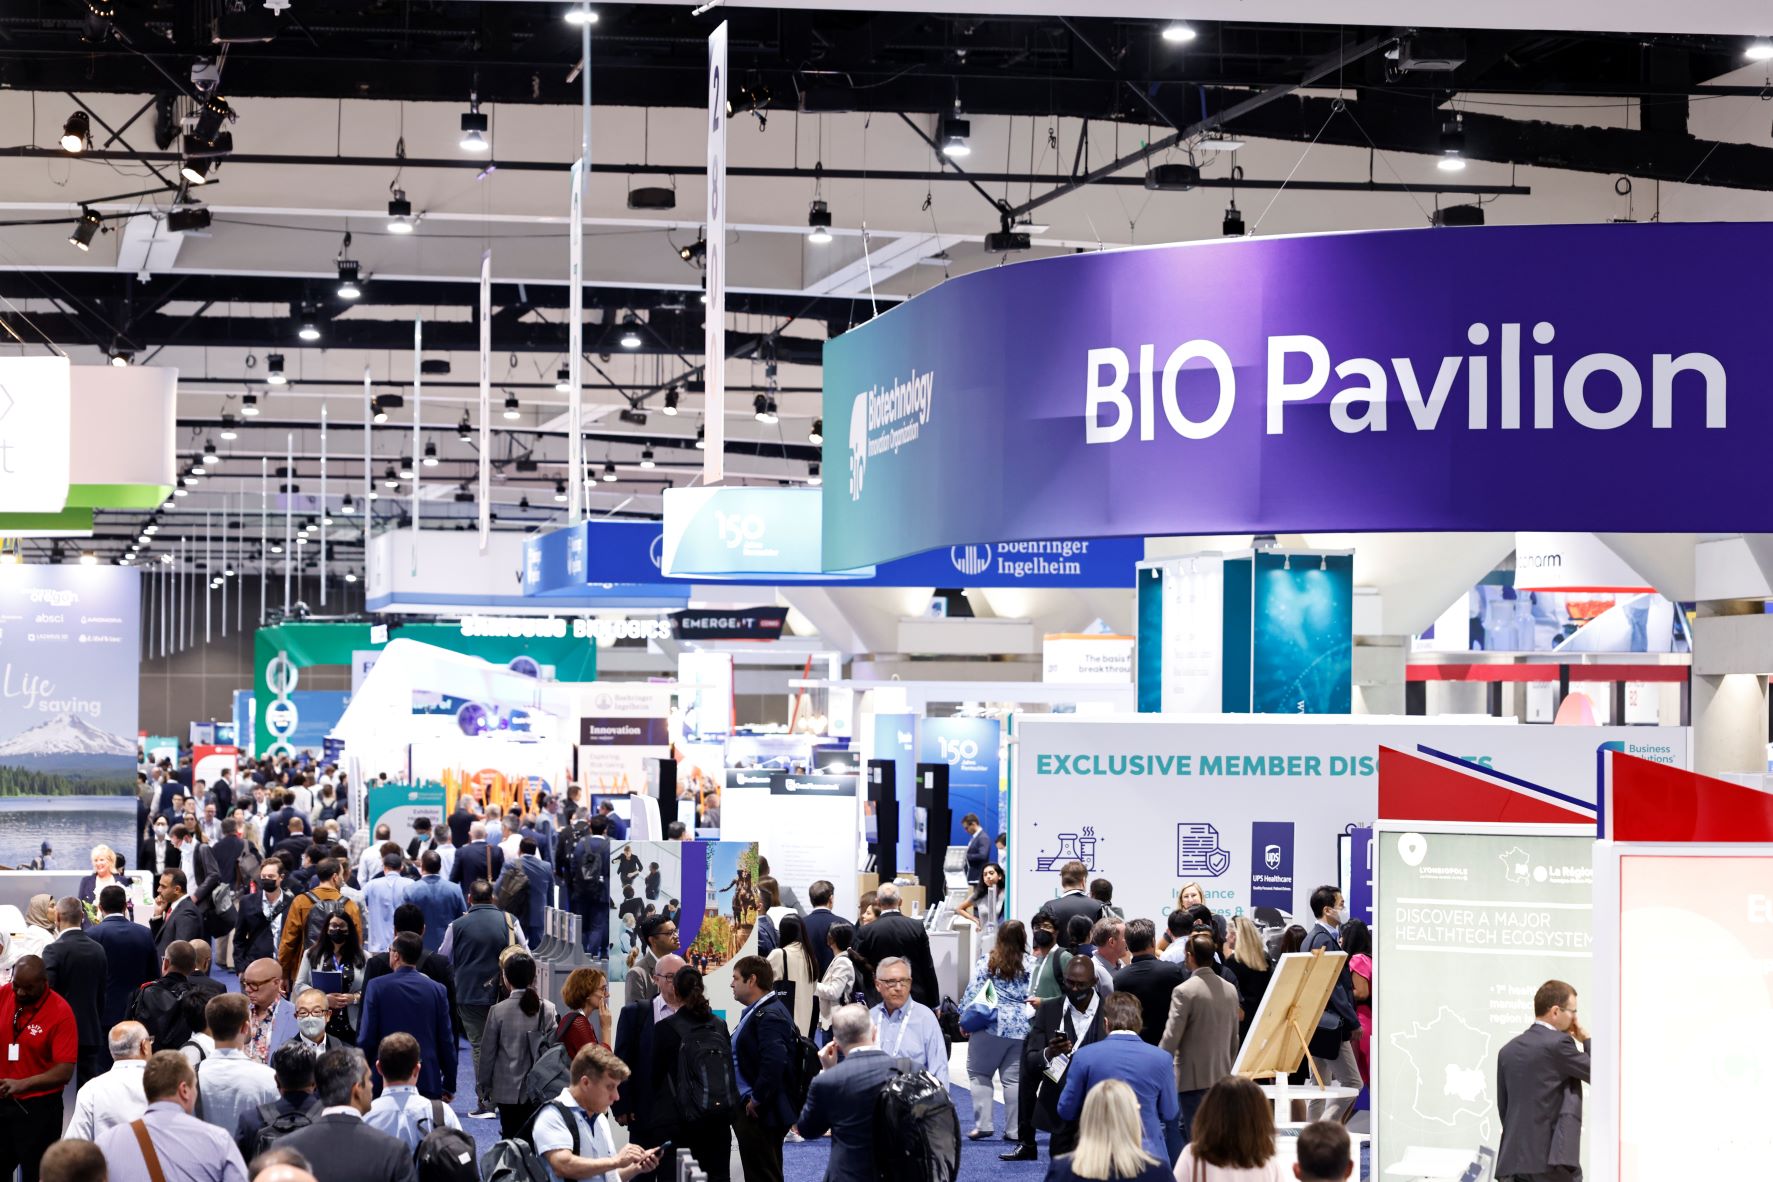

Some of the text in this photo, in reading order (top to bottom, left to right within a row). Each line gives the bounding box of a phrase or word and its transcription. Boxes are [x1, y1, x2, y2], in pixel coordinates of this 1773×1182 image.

[1086, 321, 1727, 444] BIO Pavilion
[868, 368, 934, 431] Biotechnology
[997, 557, 1081, 577] Ingelheim
[35, 613, 64, 624] absci
[4, 663, 56, 709] Life
[39, 697, 102, 717] saving
[589, 725, 641, 735] Innovation
[938, 736, 978, 766] 150
[1629, 744, 1671, 753] Business
[1037, 754, 1192, 776] EXCLUSIVE
[1200, 755, 1322, 776] MEMBER
[1252, 874, 1292, 883] UPS Healthcare
[1549, 865, 1561, 876] La
[1396, 907, 1551, 928] DISCOVER A MAJOR
[1396, 925, 1497, 945] HEALTHTECH
